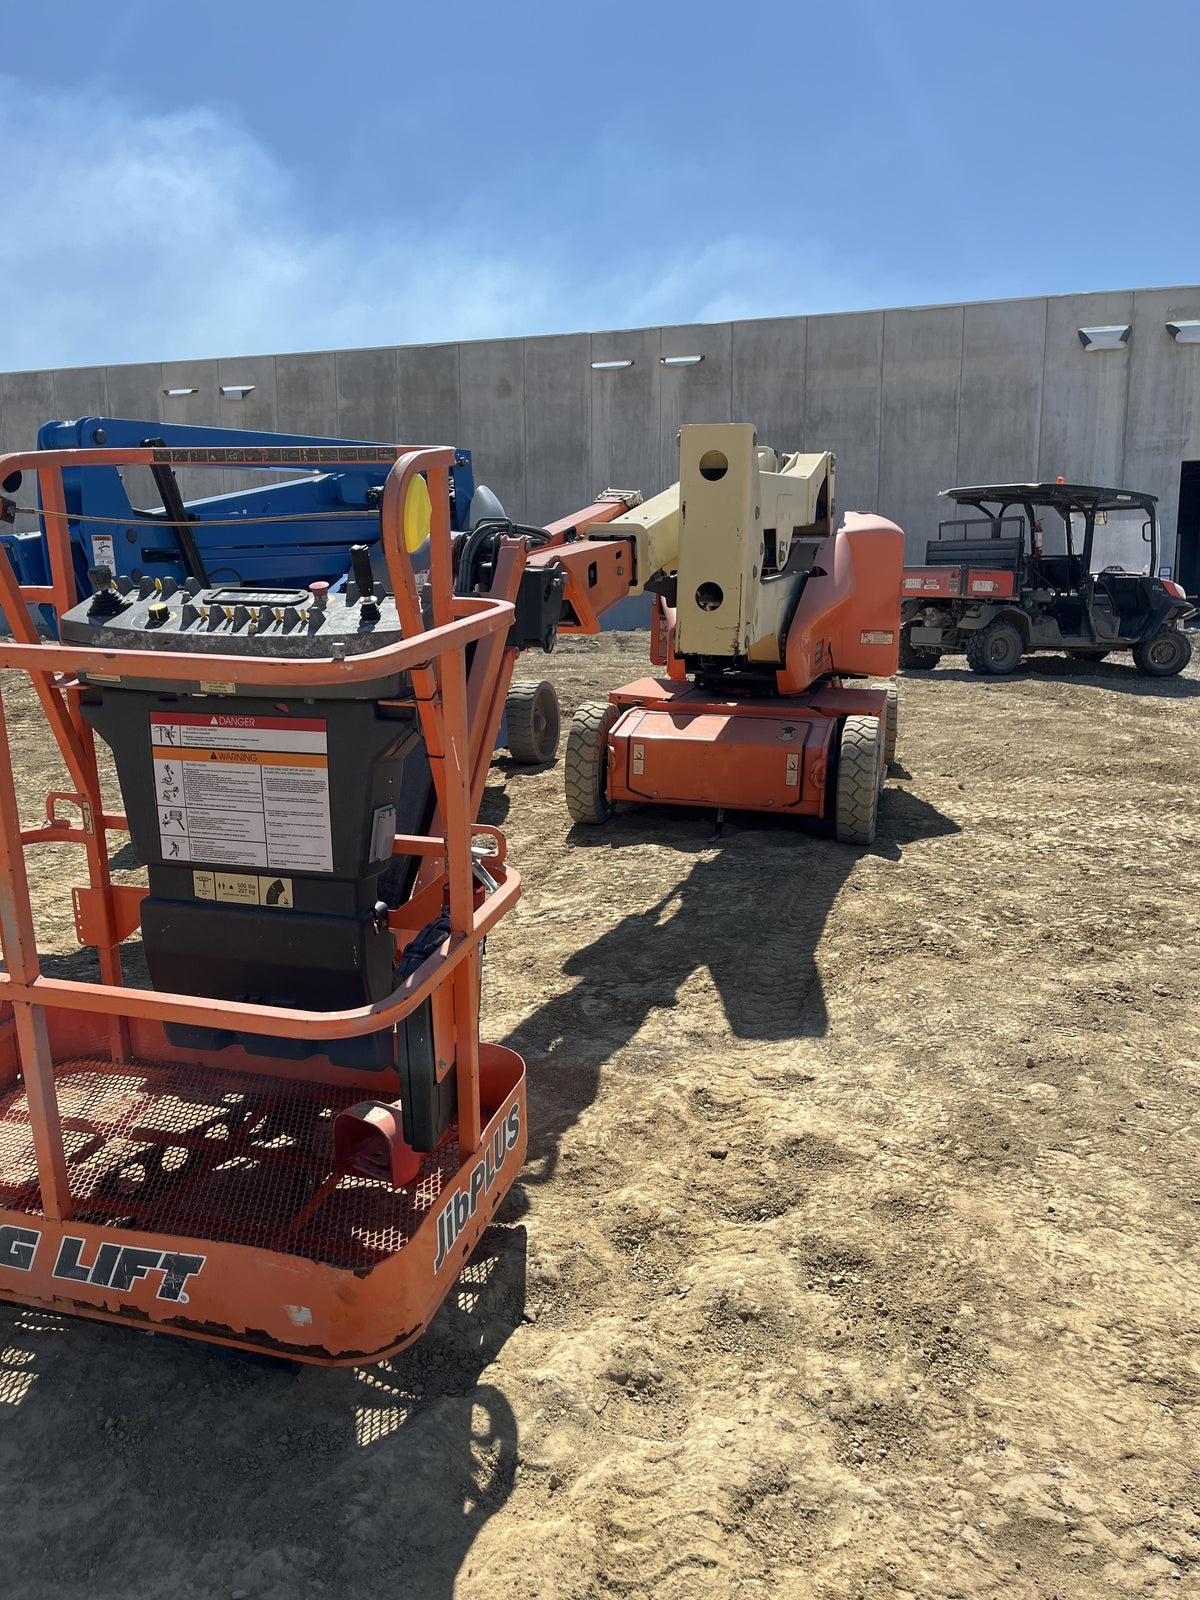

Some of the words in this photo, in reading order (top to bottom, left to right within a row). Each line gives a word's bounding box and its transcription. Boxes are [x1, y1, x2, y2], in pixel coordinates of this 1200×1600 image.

[218, 716, 256, 728] DANGER
[219, 753, 258, 763] WARNING
[434, 1102, 520, 1275] JibPLUS
[52, 1235, 207, 1302] LIFT
